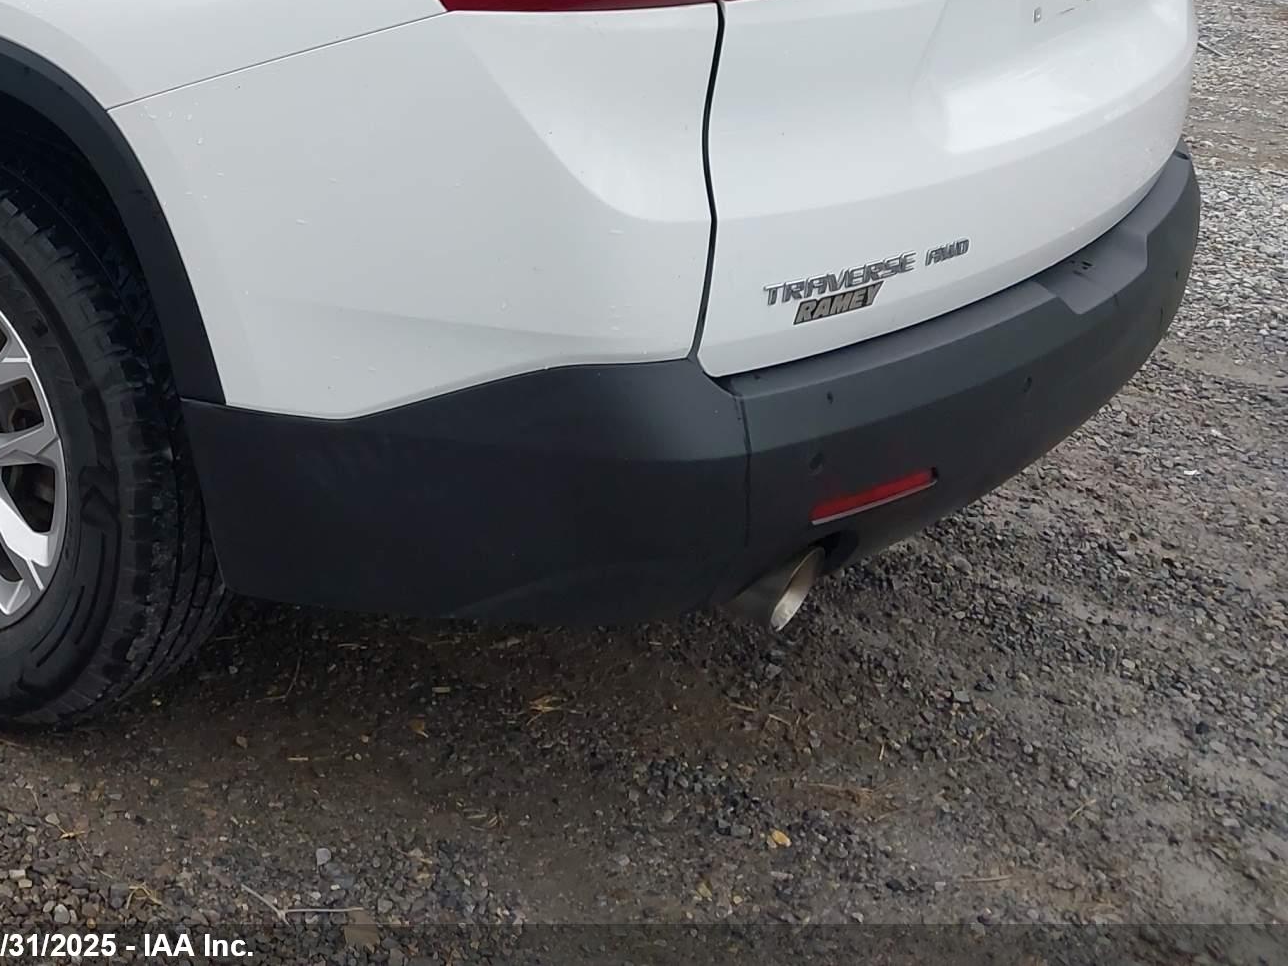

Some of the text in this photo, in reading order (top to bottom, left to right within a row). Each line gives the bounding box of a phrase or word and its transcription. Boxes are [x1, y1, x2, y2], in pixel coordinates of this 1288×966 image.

[763, 238, 970, 306] TRAVERSE AWD
[793, 280, 884, 325] RAMEY
